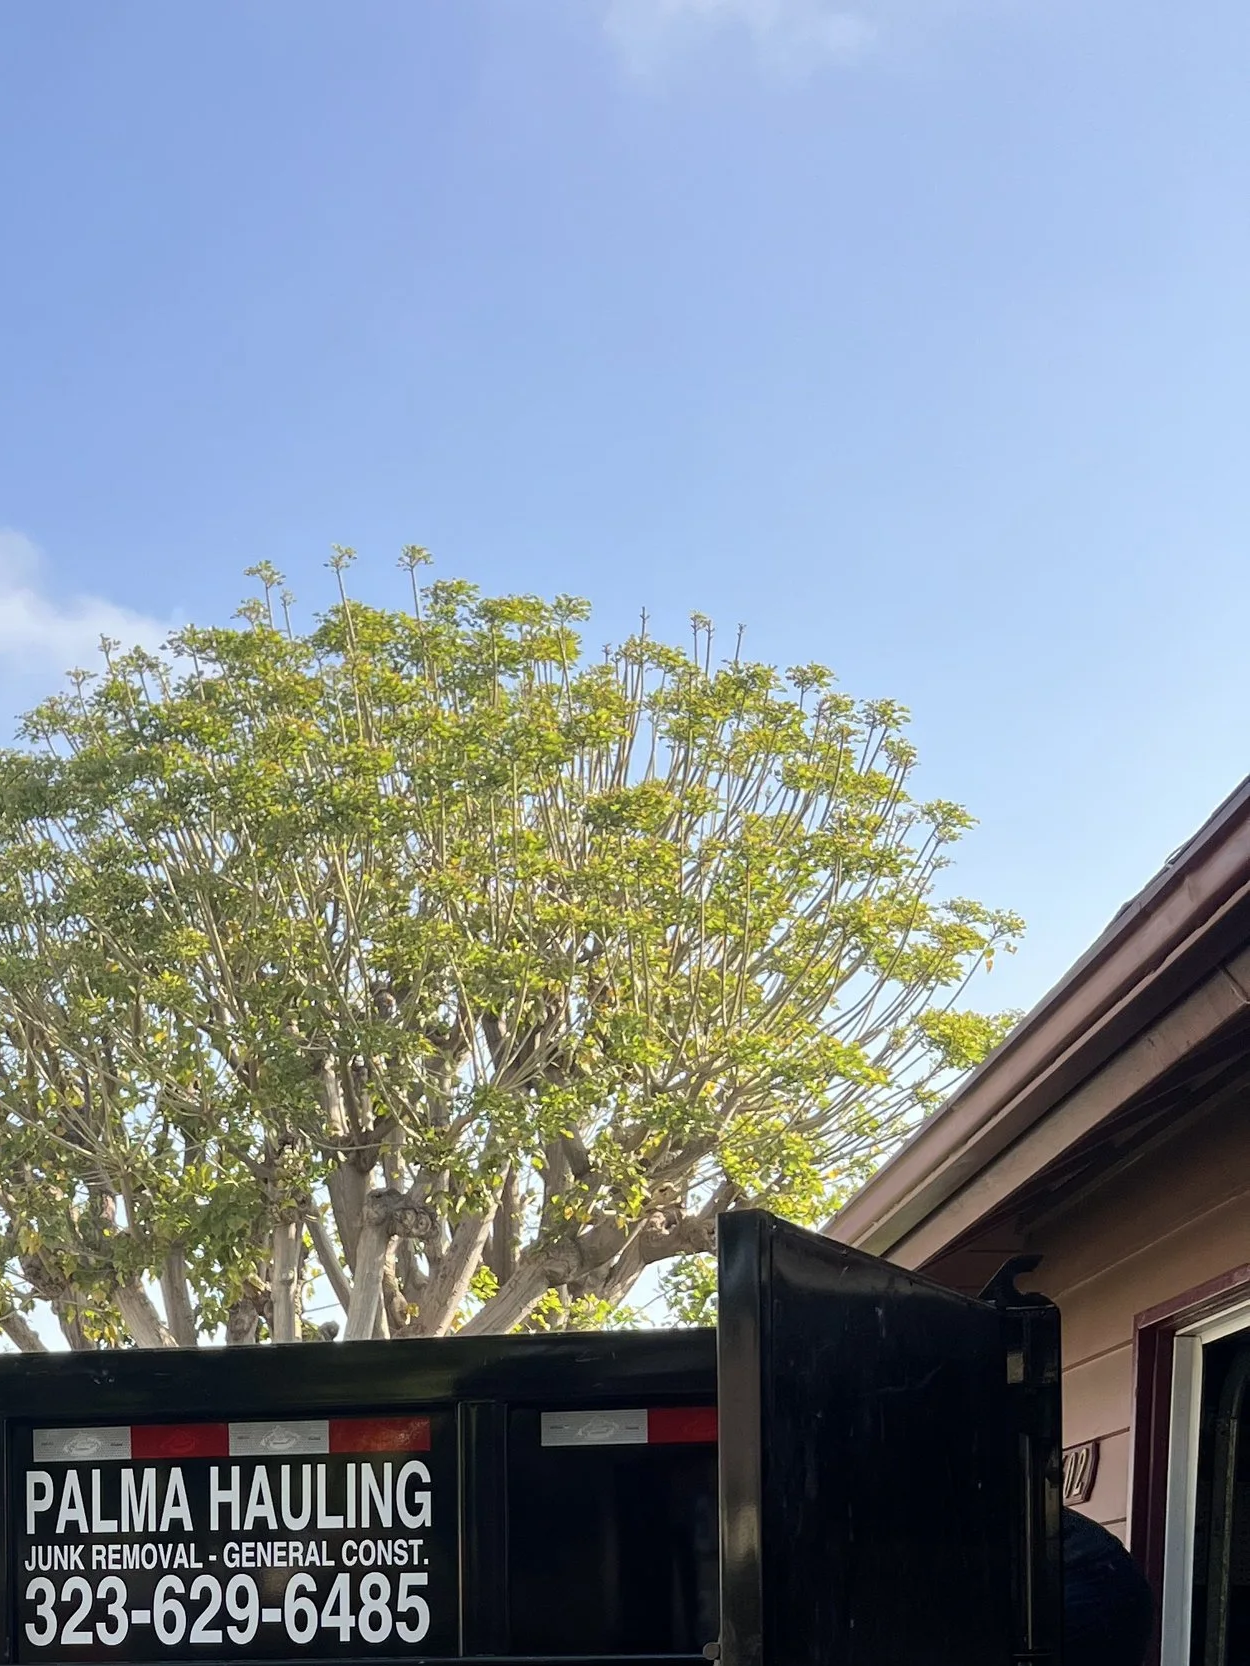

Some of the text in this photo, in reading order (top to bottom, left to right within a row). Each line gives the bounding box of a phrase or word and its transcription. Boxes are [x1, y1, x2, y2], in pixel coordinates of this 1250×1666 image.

[25, 1460, 432, 1535] PALMA HAULING
[1061, 1448, 1088, 1498] 02
[24, 1544, 86, 1572] JUNK
[91, 1542, 204, 1571] REMOVAL
[222, 1540, 336, 1569] GENERAL
[341, 1538, 430, 1567] CONST.
[24, 1571, 431, 1647] 323-629-6485
